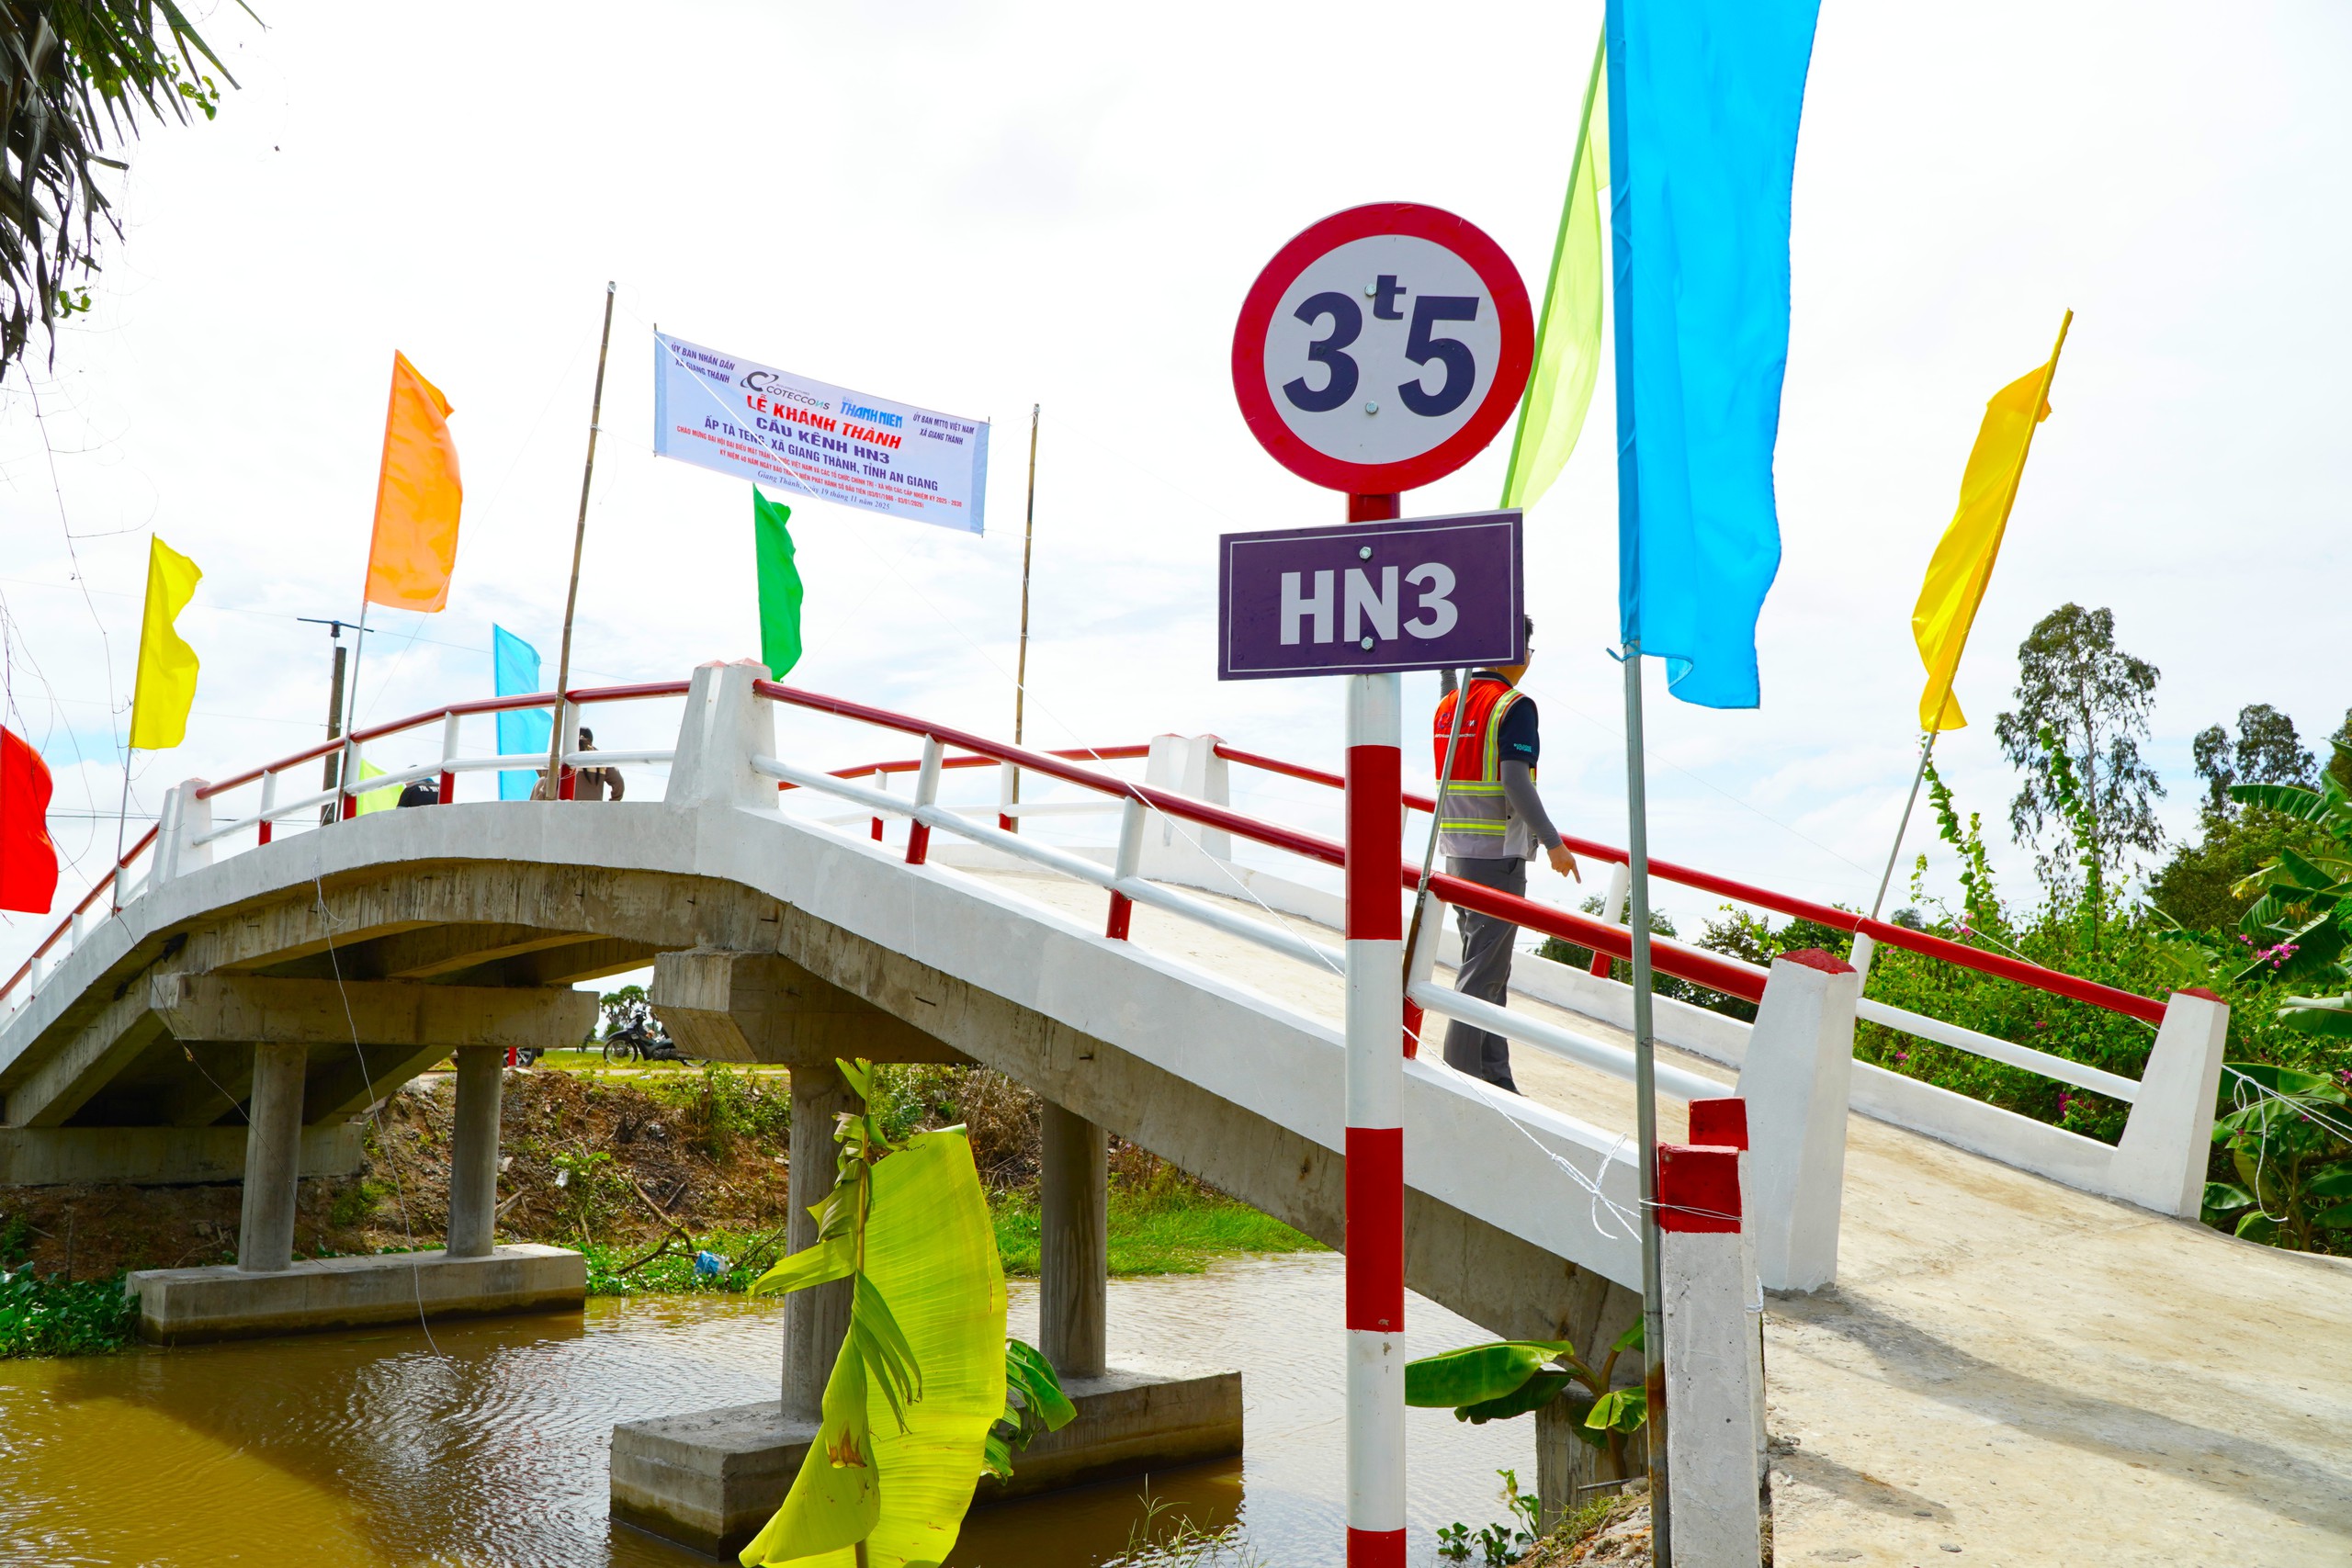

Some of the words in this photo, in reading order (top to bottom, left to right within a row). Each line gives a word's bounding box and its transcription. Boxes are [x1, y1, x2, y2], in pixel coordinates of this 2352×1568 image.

[682, 347, 696, 359] BAN
[698, 353, 718, 366] NHÂN
[719, 359, 735, 371] DÂN
[686, 362, 706, 375] GIANG
[707, 369, 729, 383] THÀNH
[747, 393, 768, 413] LỄ
[774, 402, 837, 432] KHÁNH
[842, 423, 902, 449] THÀNH
[840, 401, 878, 423] THANH
[921, 415, 933, 424] BAN
[933, 419, 948, 430] MTTQ
[950, 421, 961, 432] VIỆT
[961, 424, 974, 434] NAM
[757, 417, 792, 437] CẦU
[797, 430, 847, 454] KÊNH
[854, 445, 890, 465] HN3
[928, 430, 944, 441] GIANG
[945, 434, 963, 445] THÀNH
[705, 415, 718, 431] ẤP
[722, 423, 735, 436] TÀ
[772, 438, 785, 452] XÃ
[788, 445, 820, 463] GIANG
[823, 454, 860, 474] THÀNH,
[863, 463, 886, 479] TỈNH
[889, 470, 904, 483] AN
[907, 475, 938, 491] GIANG
[802, 463, 812, 471] NAM
[758, 470, 777, 483] Giang
[779, 476, 801, 489] Thành,
[831, 491, 849, 502] tháng
[859, 497, 873, 507] năm
[875, 501, 890, 510] 2025
[1281, 562, 1459, 645] HN3
